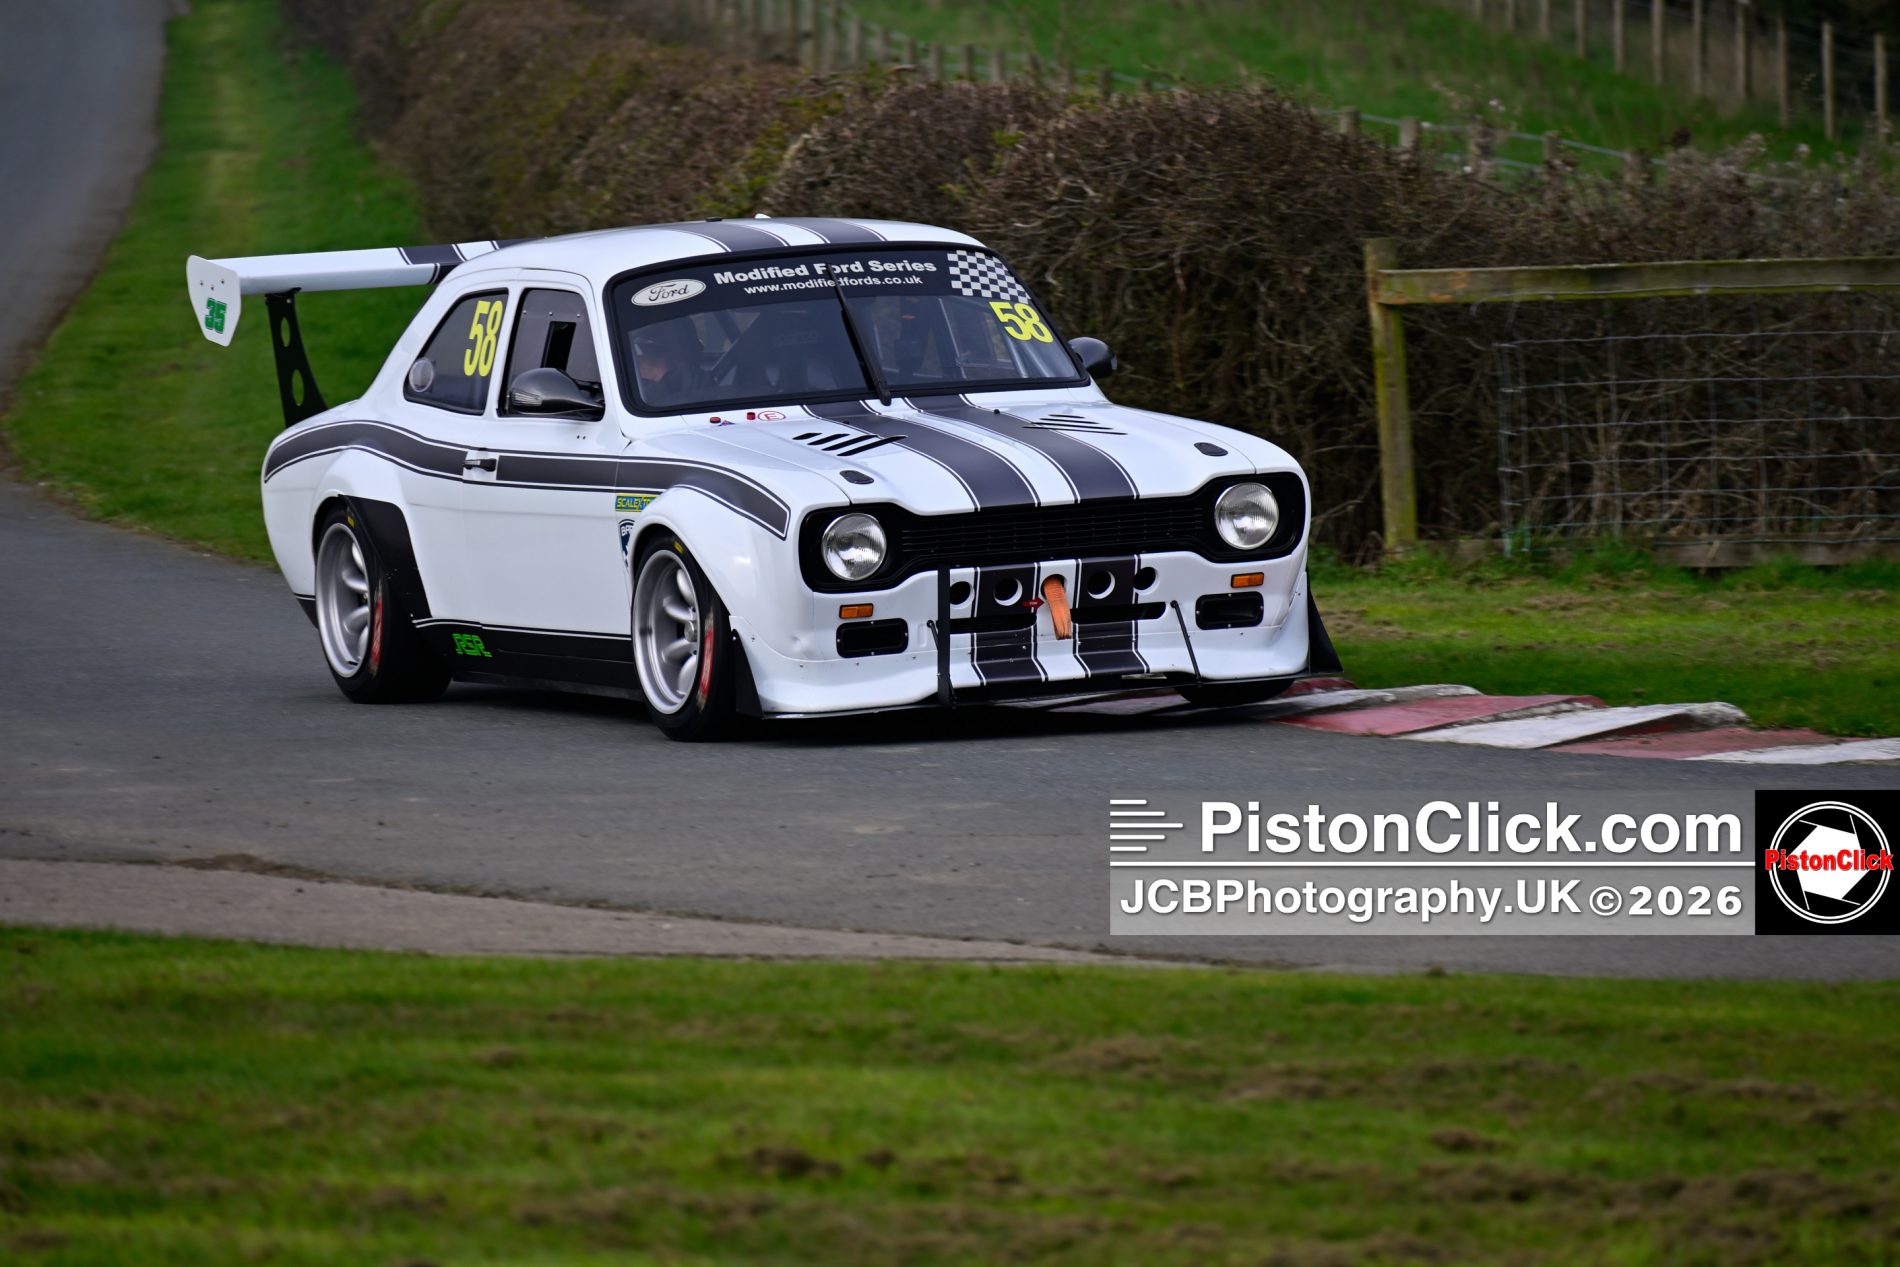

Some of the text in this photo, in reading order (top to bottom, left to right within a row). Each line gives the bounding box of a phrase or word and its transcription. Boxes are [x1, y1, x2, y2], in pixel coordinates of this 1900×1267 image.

[713, 259, 937, 285] Modified Ford Series
[744, 275, 923, 295] www.modifiedfords.co.uk
[648, 283, 690, 302] Ford
[205, 297, 227, 334] 35
[989, 302, 1053, 343] 58
[464, 301, 502, 376] 58
